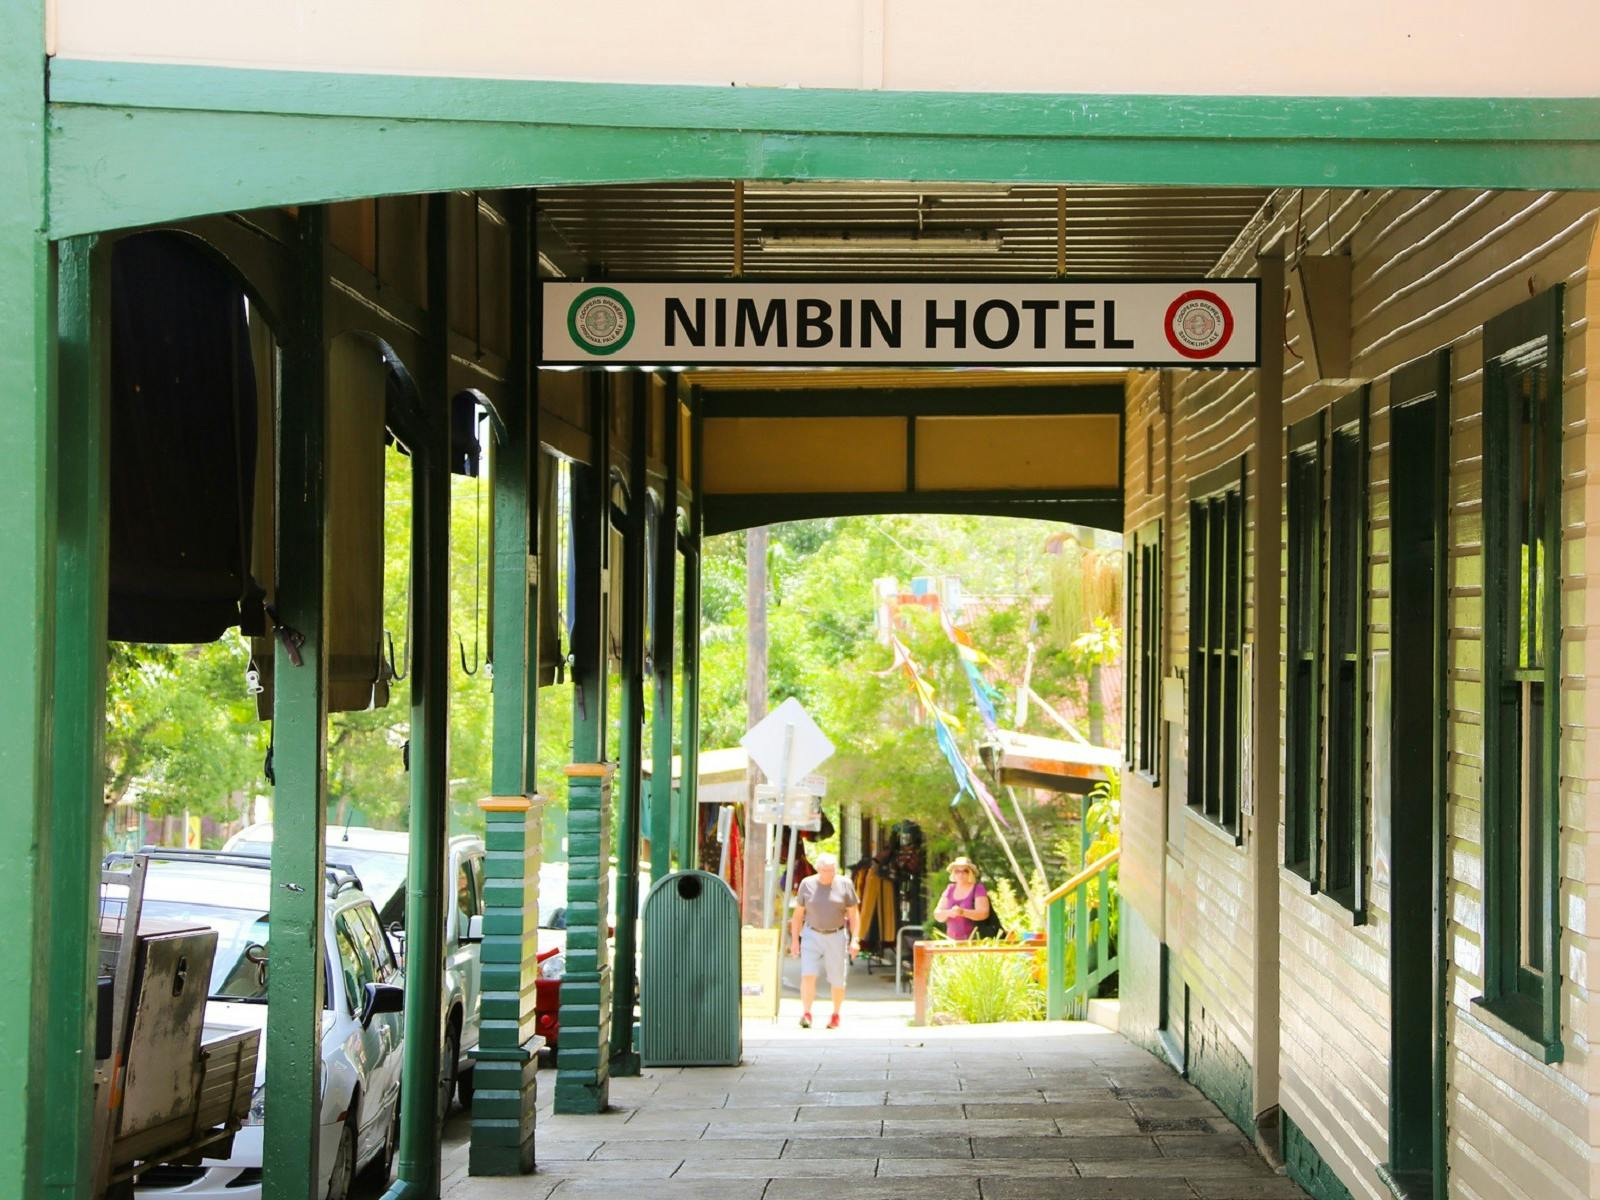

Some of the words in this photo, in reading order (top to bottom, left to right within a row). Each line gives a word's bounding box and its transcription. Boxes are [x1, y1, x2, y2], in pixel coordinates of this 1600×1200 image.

[579, 299, 601, 319] COOPERS
[1177, 302, 1199, 322] COOPERS
[1200, 302, 1220, 322] BREWERY
[665, 298, 901, 348] NIMBIN
[925, 299, 1134, 350] HOTEL
[1178, 331, 1209, 346] SPARKLING
[1209, 332, 1219, 342] ALE
